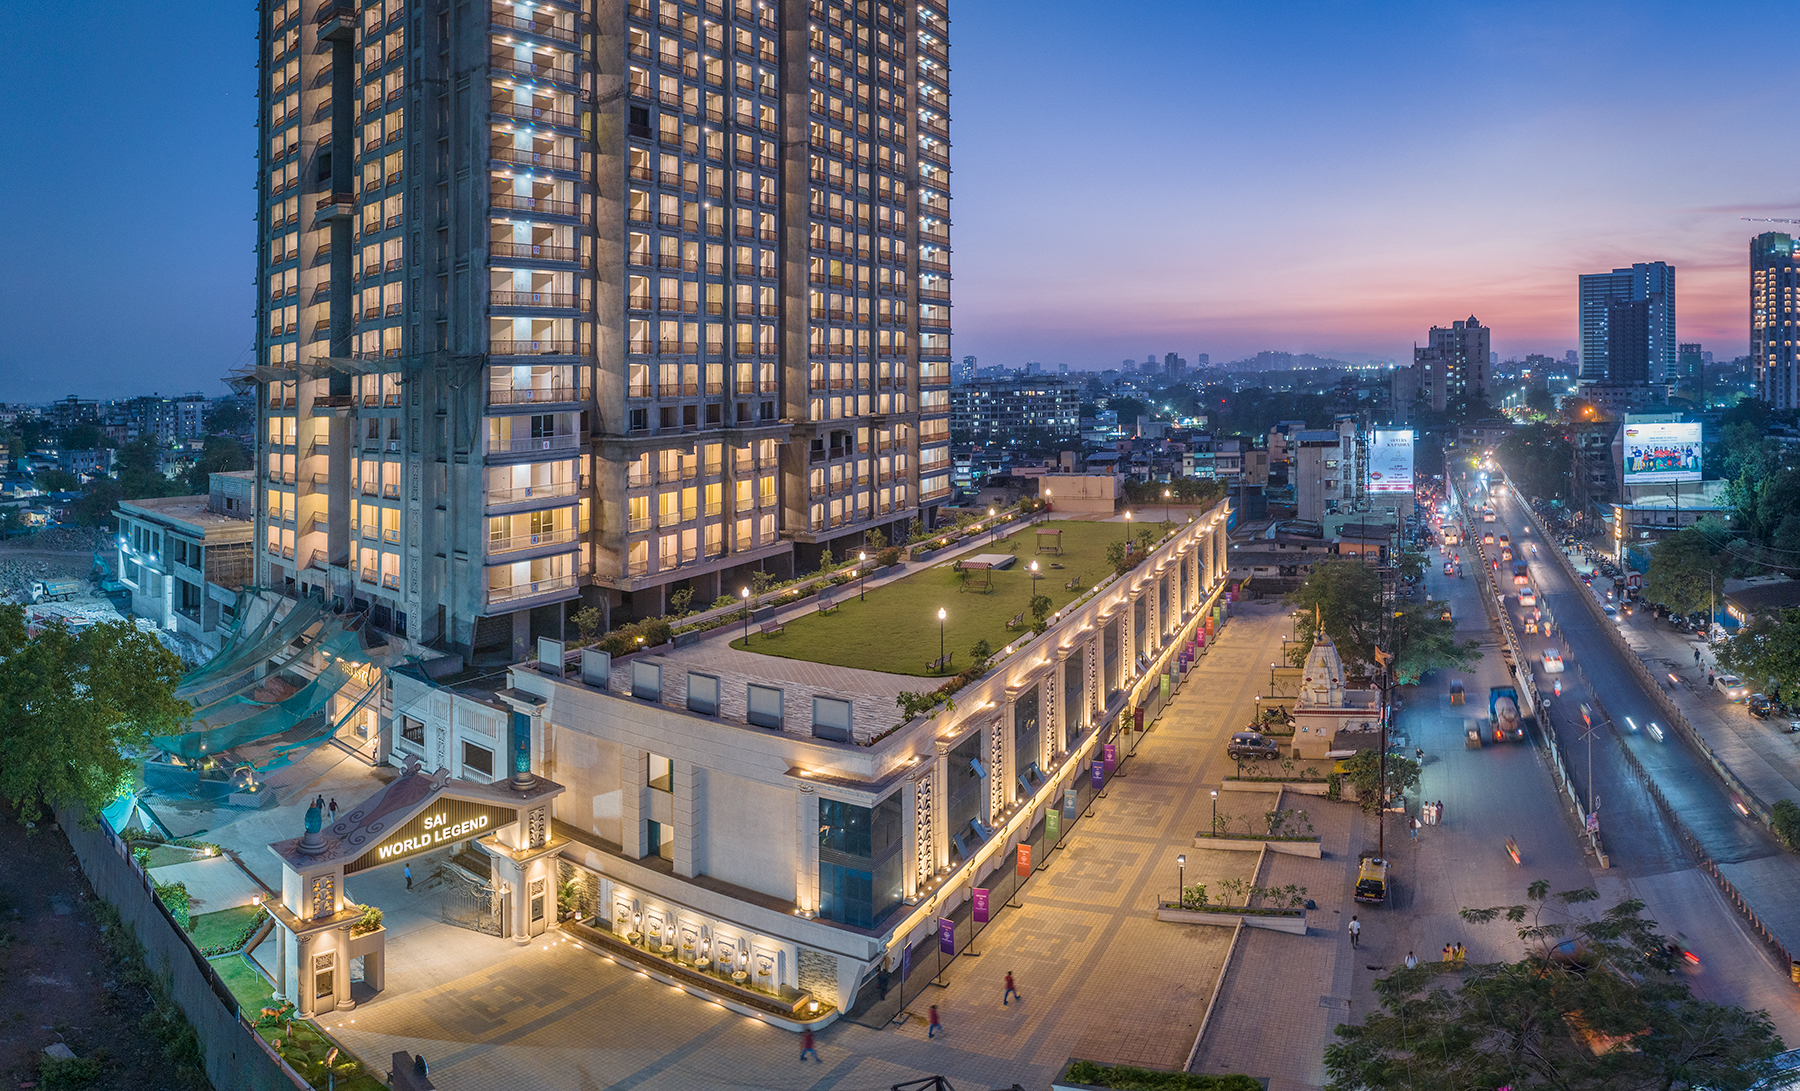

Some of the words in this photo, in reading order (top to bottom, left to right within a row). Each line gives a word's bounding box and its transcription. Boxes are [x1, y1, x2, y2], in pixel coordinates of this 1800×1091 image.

[424, 813, 447, 830] SAI
[379, 834, 431, 859] WORLD
[434, 815, 488, 842] LEGEND
